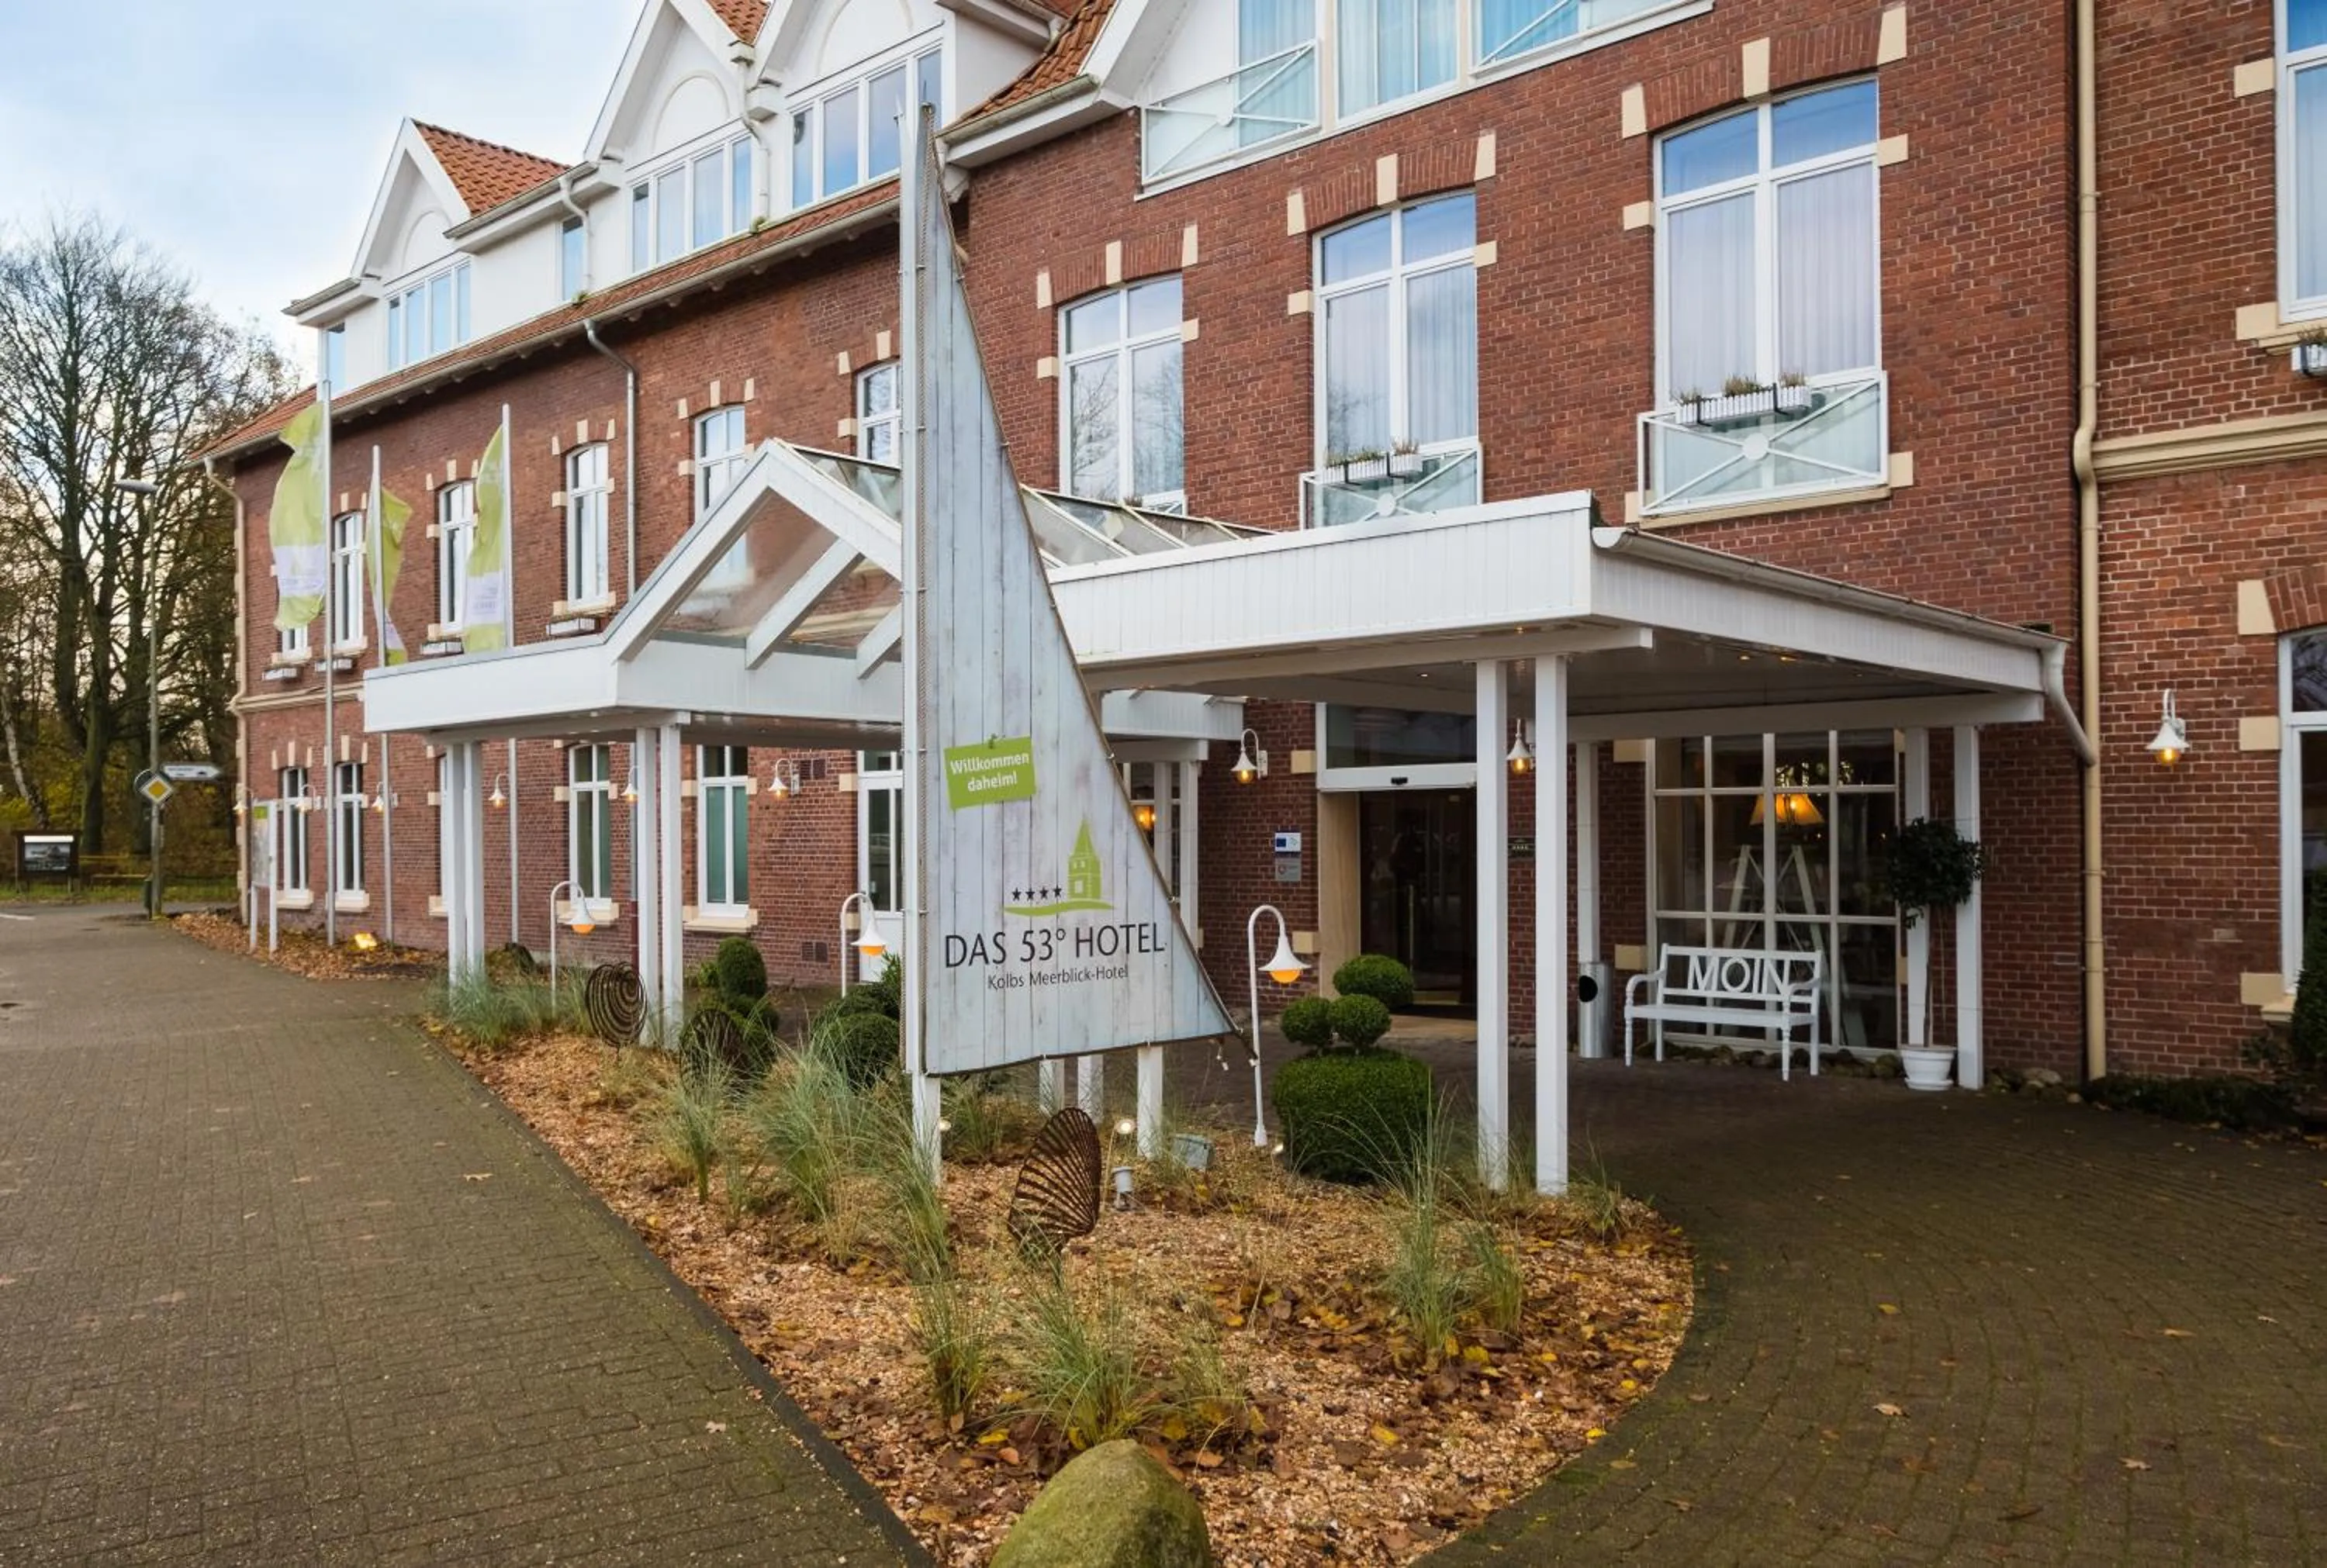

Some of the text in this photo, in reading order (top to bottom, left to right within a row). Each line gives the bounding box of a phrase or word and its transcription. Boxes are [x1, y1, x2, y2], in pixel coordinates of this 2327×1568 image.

[950, 752, 1030, 775] Willkommen
[967, 770, 1018, 792] daheim!
[945, 922, 1165, 968] DAS 53° HOTEL
[987, 965, 1129, 990] Kolbs Meerblick-Hotel
[1687, 955, 1790, 995] MOIN
